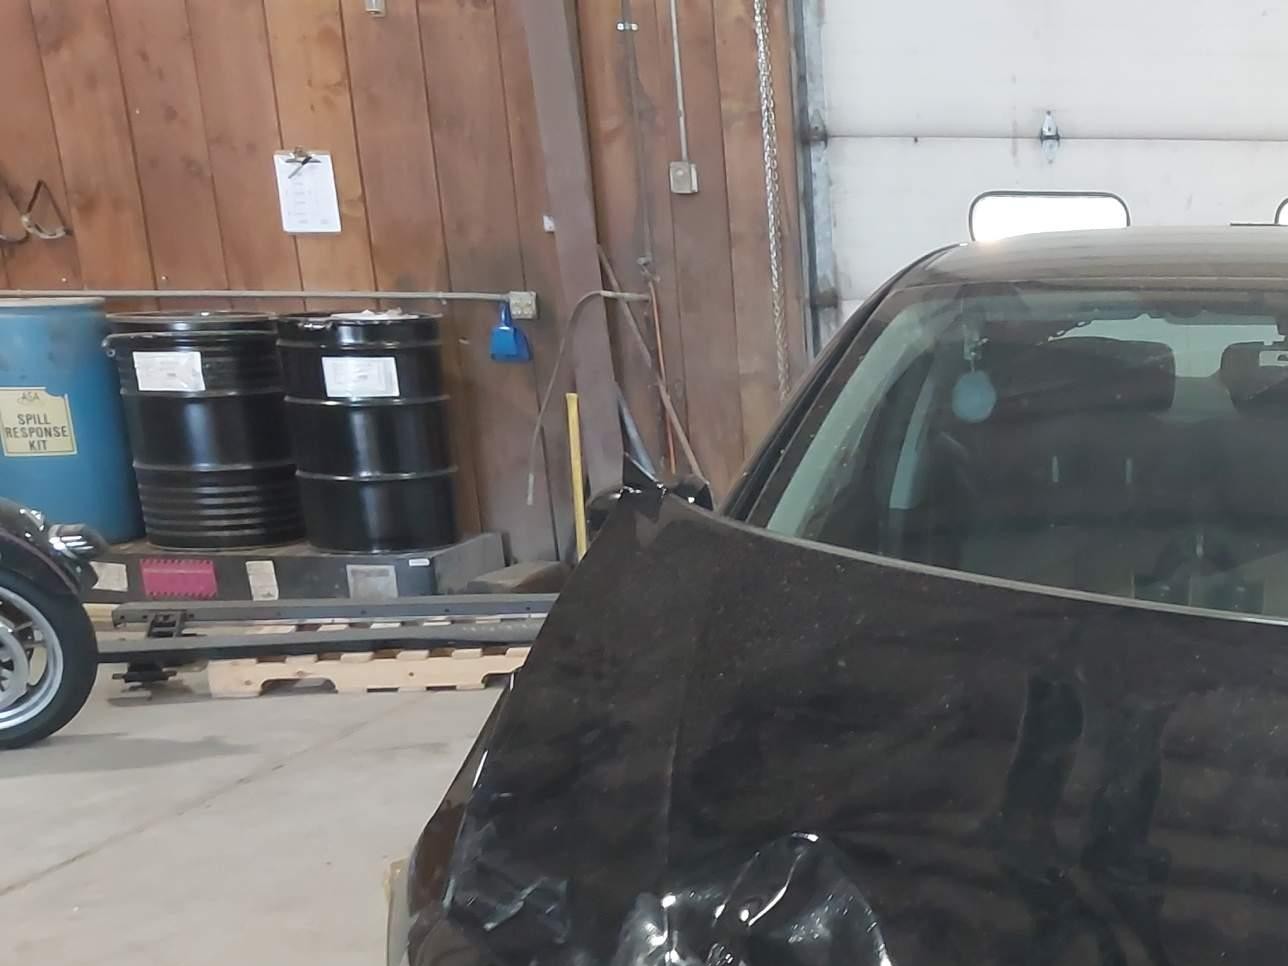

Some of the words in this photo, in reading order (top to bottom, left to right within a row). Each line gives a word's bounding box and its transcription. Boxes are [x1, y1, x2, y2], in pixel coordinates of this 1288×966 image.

[17, 413, 50, 425] SPILL
[4, 426, 69, 438] RESPONSE
[28, 440, 48, 451] KIT
